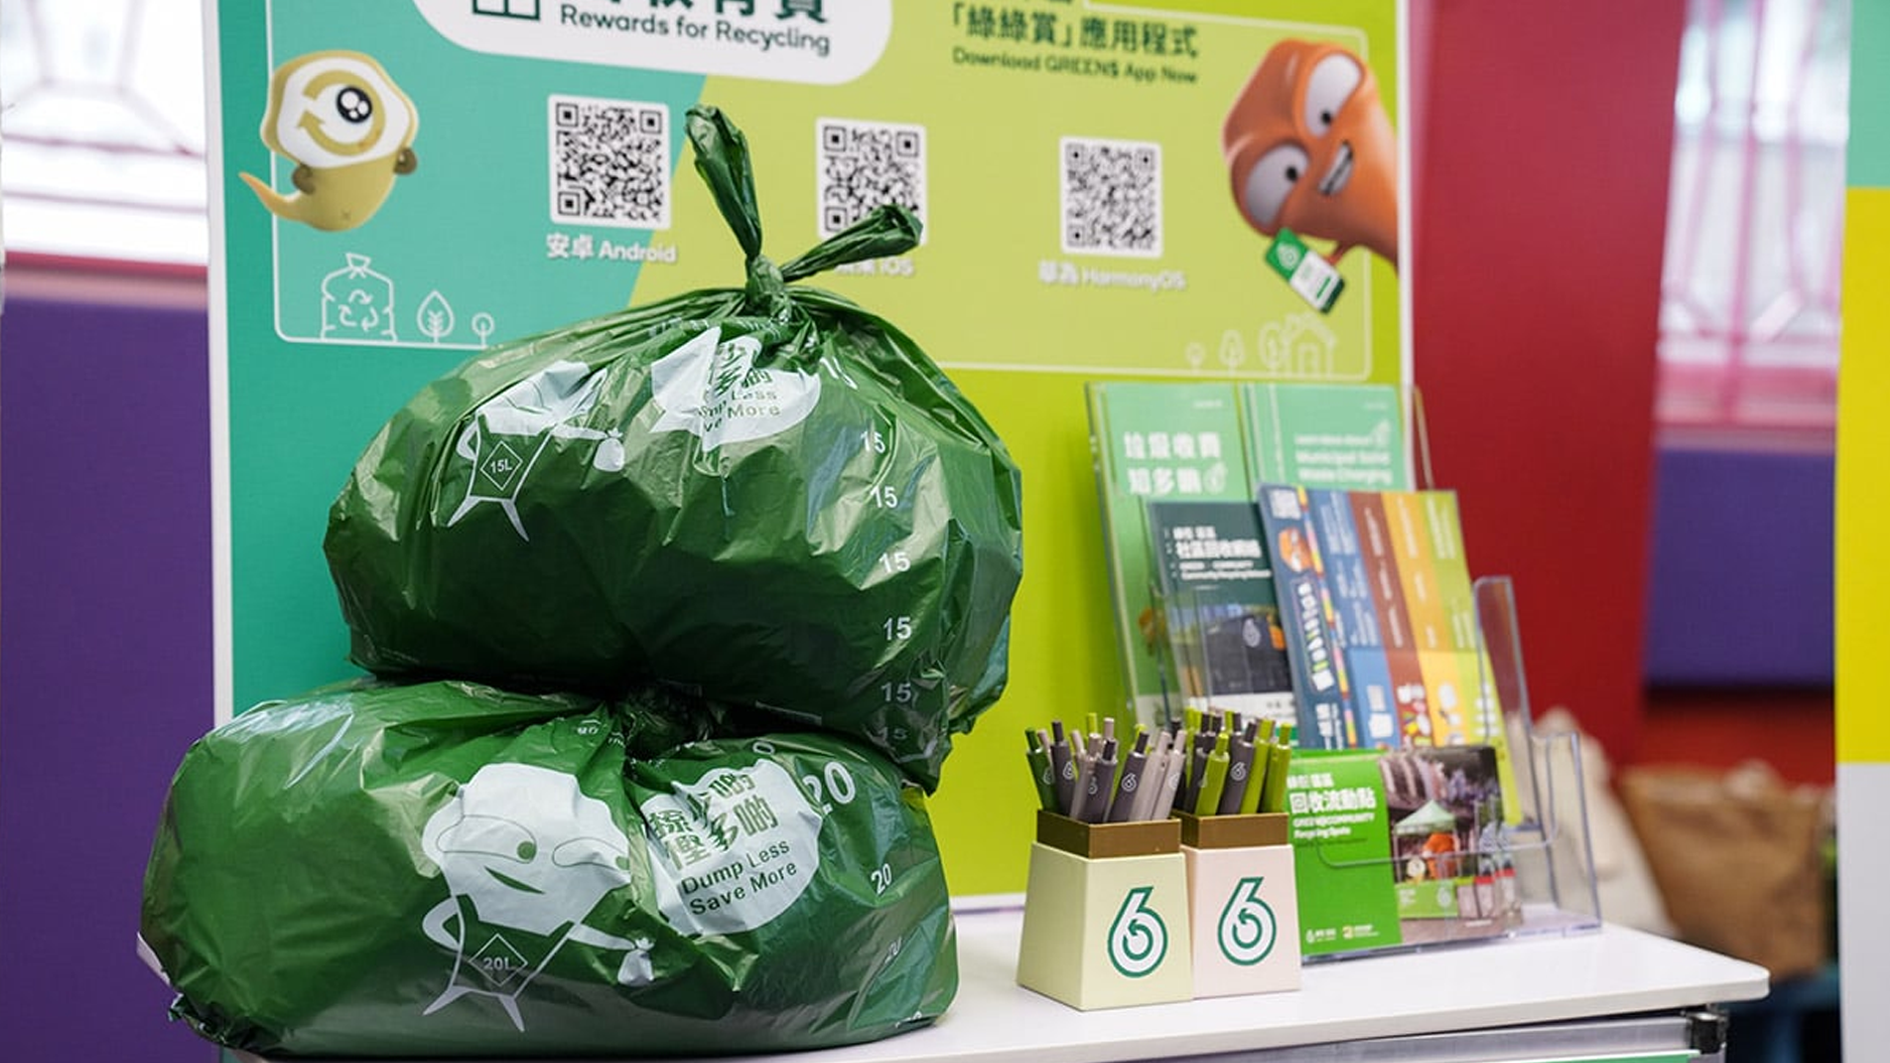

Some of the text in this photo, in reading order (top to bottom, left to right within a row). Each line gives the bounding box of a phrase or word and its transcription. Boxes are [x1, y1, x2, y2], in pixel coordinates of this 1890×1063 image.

[560, 4, 669, 35] Rewards
[676, 15, 707, 39] for
[716, 20, 830, 57] Recycling
[953, 46, 1040, 71] Download
[1124, 62, 1156, 83] App
[1161, 66, 1197, 83] Now
[546, 232, 677, 263] 安卓 Android
[1083, 267, 1186, 293] HarmonyOS
[727, 403, 781, 418] More
[861, 431, 886, 453] 15
[489, 457, 513, 474] 15L
[870, 486, 898, 508] 15
[879, 551, 911, 573] 15
[883, 616, 912, 639] 15
[881, 681, 912, 703] 15
[802, 761, 856, 814] 20
[681, 840, 790, 896] Dump Less
[870, 862, 893, 895] 20
[690, 861, 797, 916] Save More
[483, 956, 512, 971] 20L
